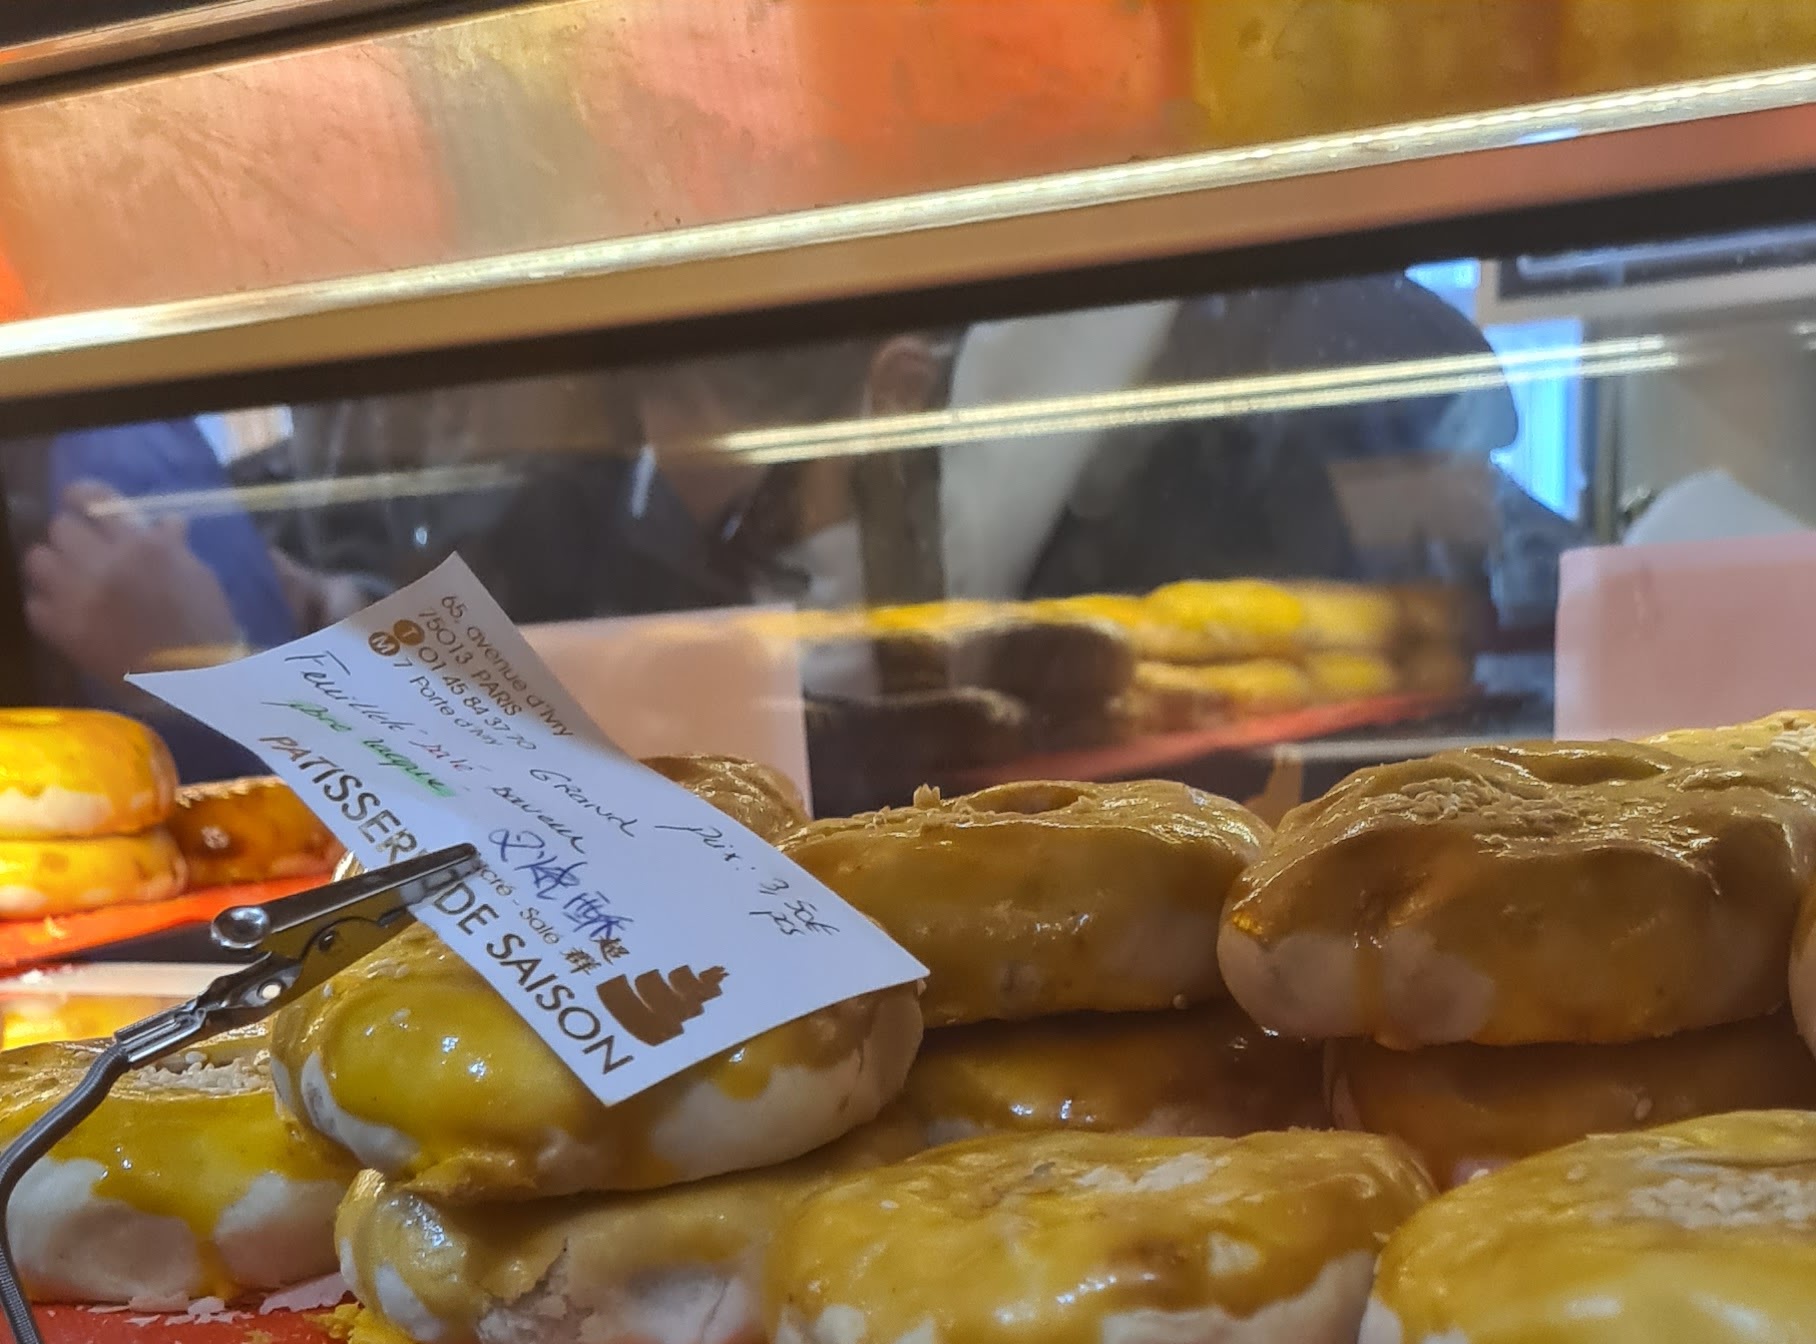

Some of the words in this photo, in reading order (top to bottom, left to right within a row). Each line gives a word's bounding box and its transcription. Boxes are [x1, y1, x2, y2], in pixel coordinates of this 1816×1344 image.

[393, 657, 413, 669] 7
[409, 675, 455, 717] Porte
[418, 609, 473, 665] 75013
[471, 669, 522, 716] PARIS
[418, 646, 447, 672] 01
[443, 674, 469, 695] 45
[464, 696, 489, 715] 84
[485, 717, 511, 733] 37
[467, 626, 527, 692] avenue
[527, 694, 574, 738] d'Ivry
[519, 907, 562, 944] Salé
[433, 881, 500, 935] DE
[487, 933, 635, 1075] SAISON
